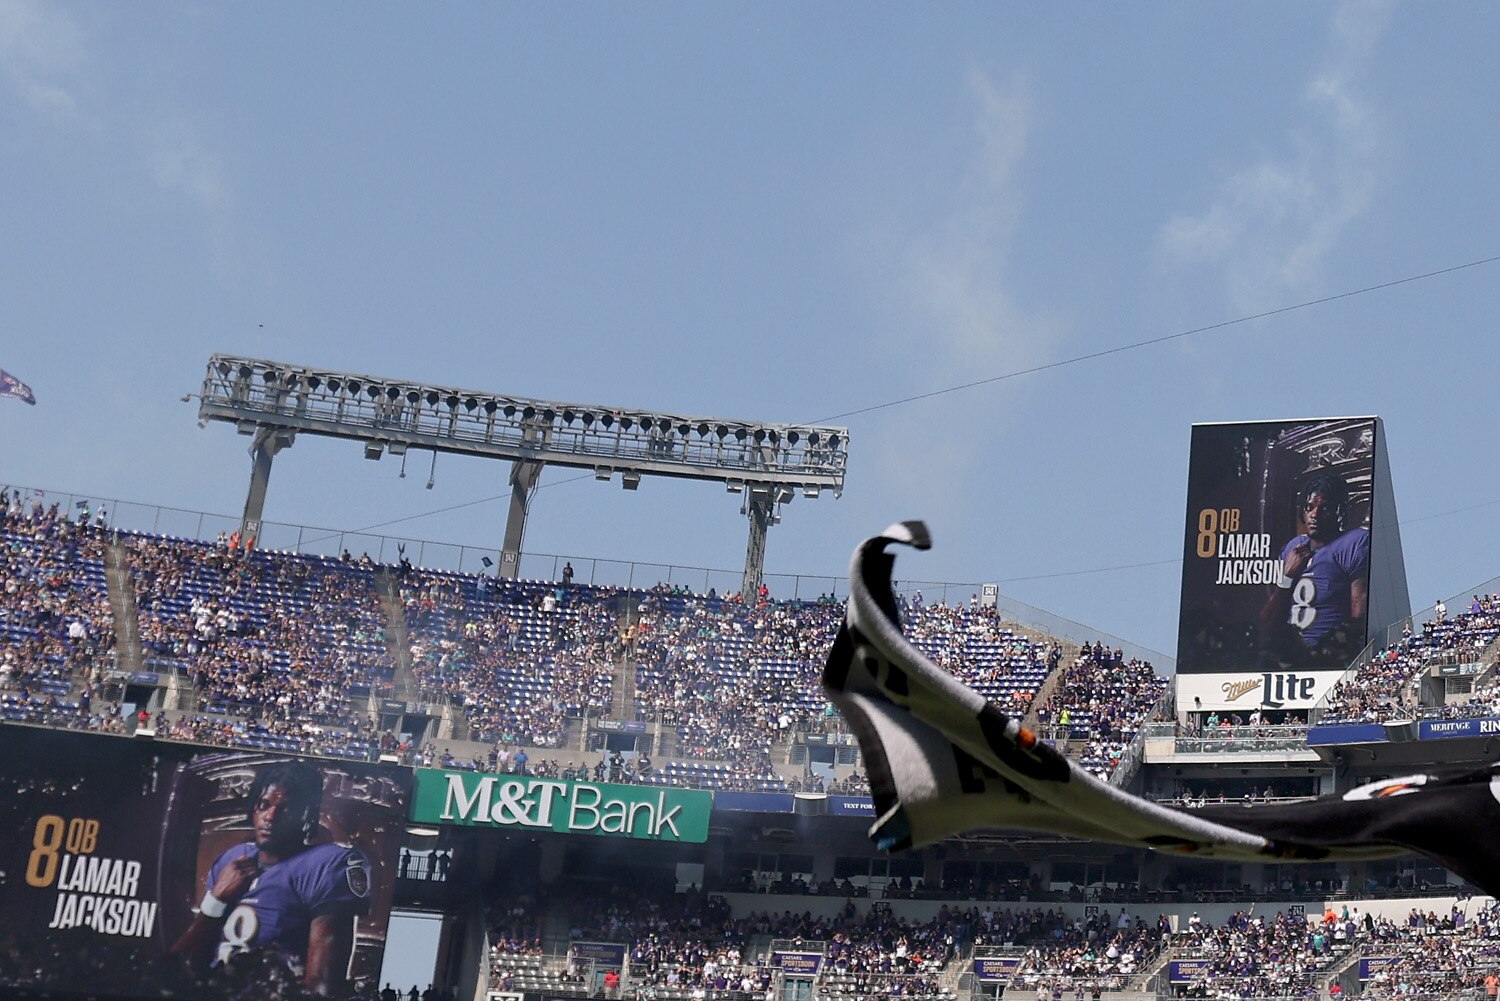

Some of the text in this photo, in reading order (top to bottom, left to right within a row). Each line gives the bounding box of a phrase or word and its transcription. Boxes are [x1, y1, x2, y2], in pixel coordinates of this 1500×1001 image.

[1196, 508, 1240, 558] 8 QB
[1217, 533, 1271, 558] LAMAR
[1215, 559, 1284, 585] JACKSON
[1221, 673, 1315, 708] Miller Lite
[1430, 721, 1471, 732] MERITAGE
[440, 774, 567, 827] M&T
[568, 784, 682, 837] Bank
[25, 815, 100, 888] 8 QB
[57, 854, 142, 897] LAMAR
[49, 893, 158, 938] JACKSON
